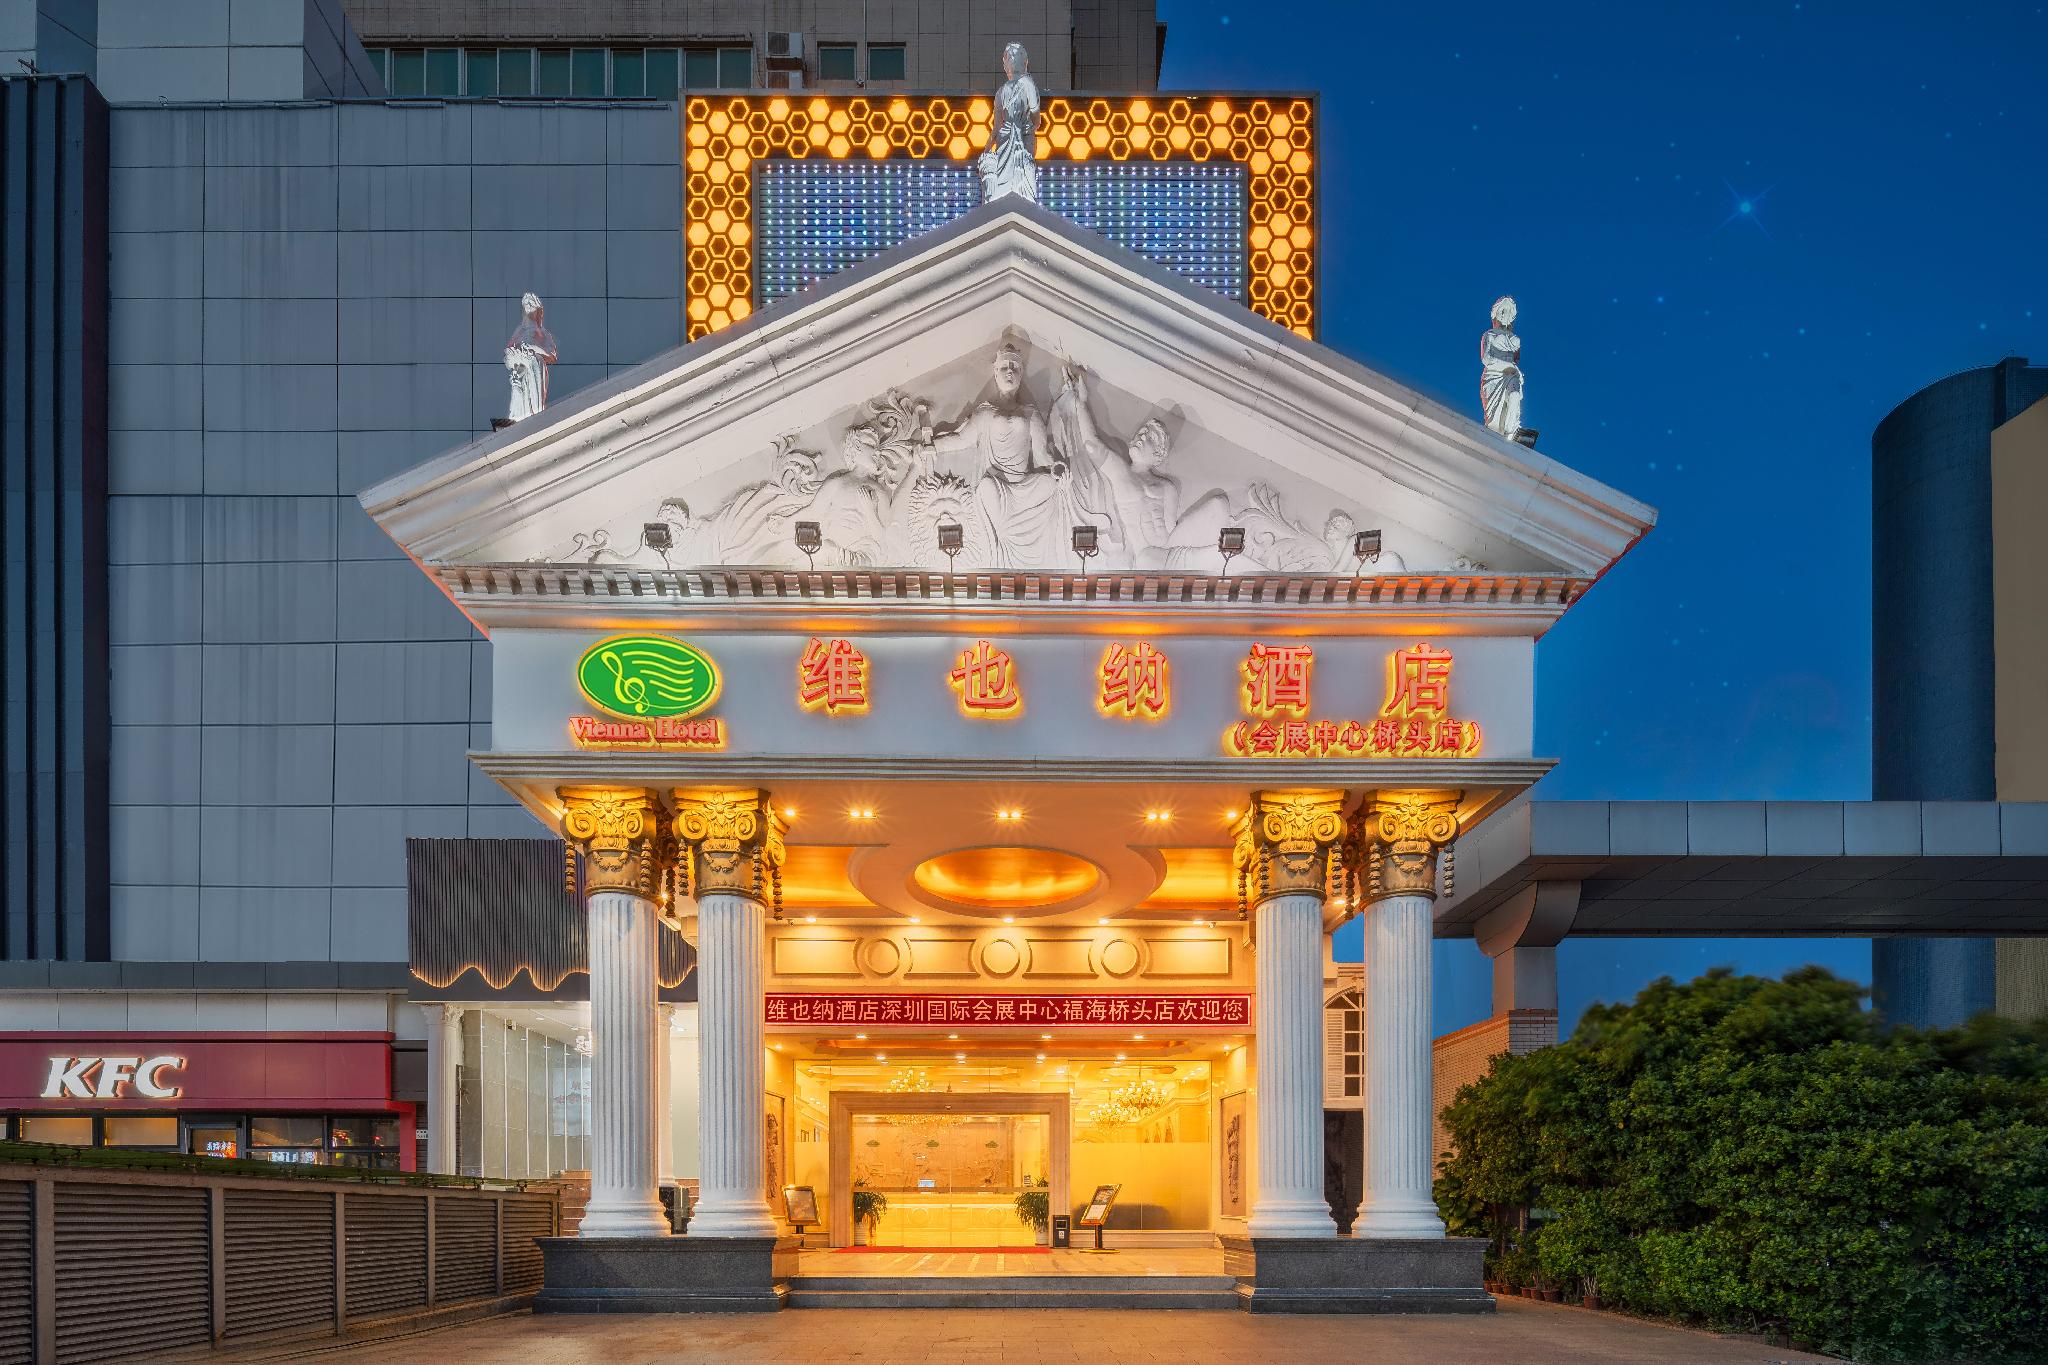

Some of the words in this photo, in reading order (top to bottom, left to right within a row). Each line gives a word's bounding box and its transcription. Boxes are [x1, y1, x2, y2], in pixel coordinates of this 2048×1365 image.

[801, 636, 1453, 714] 维也纳酒店
[569, 717, 649, 742] Vienna
[654, 717, 720, 743] Hotel
[767, 999, 1244, 1021] 维也纳酒店深圳国际会展中心福海桥头店欢迎您
[40, 1056, 182, 1098] KFC
